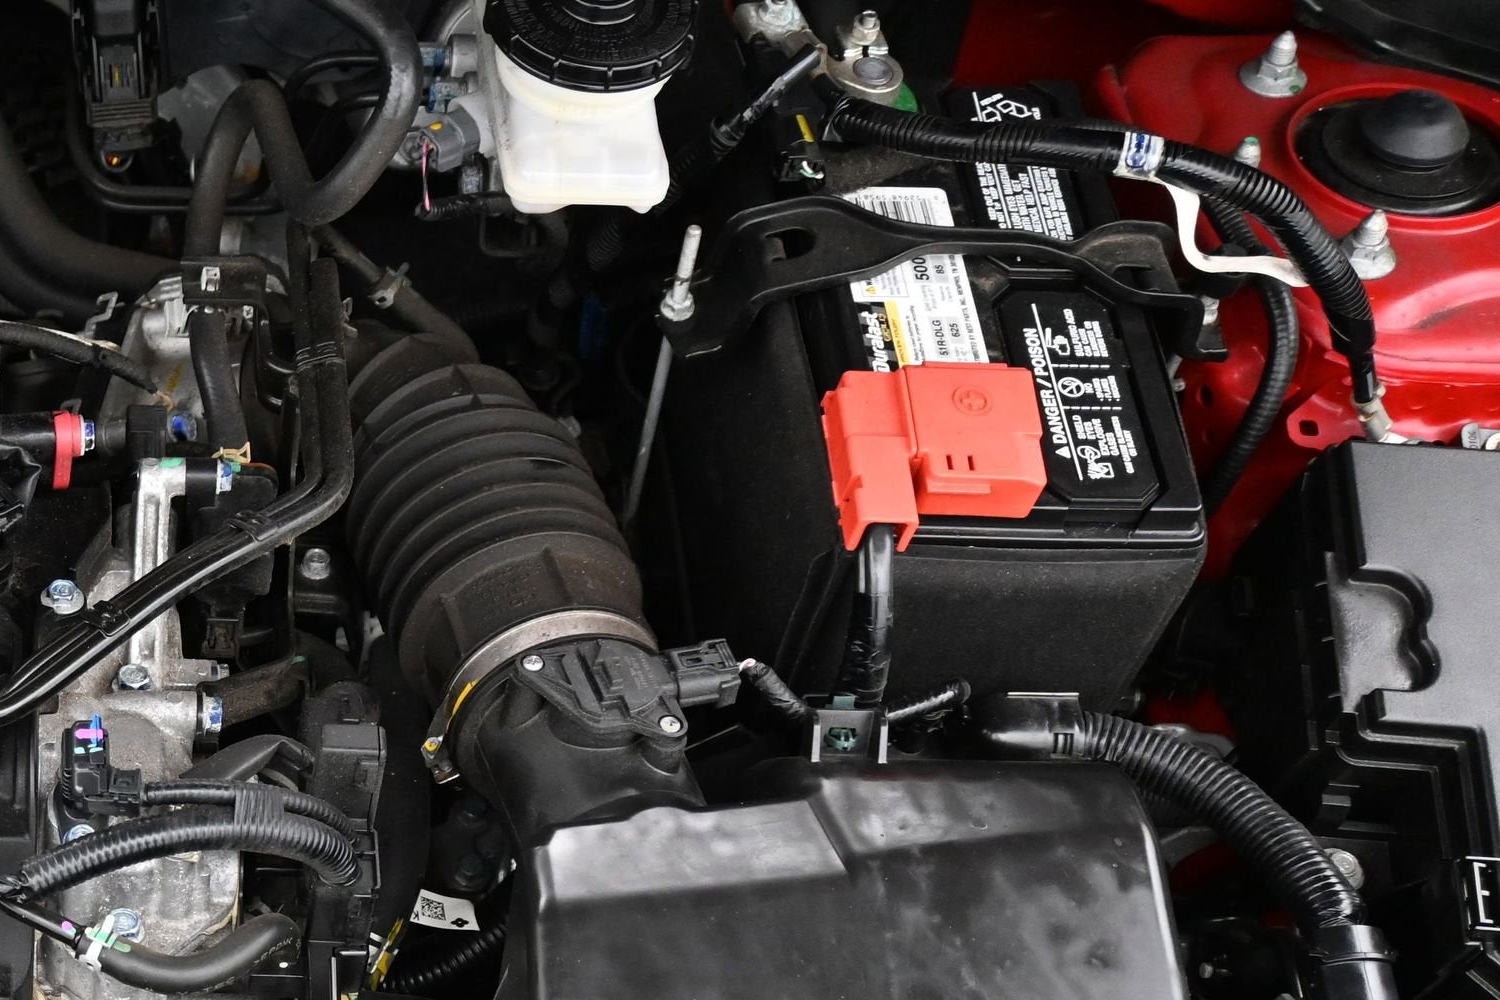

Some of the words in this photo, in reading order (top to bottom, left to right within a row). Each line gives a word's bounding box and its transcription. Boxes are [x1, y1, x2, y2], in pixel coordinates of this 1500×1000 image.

[1010, 179, 1022, 192] GET
[1005, 196, 1019, 212] EYES
[1023, 189, 1035, 205] HELP
[1010, 211, 1024, 229] LUSH
[911, 257, 930, 281] 500
[934, 264, 945, 275] 85
[932, 319, 949, 356] 51R-DLG
[951, 323, 961, 337] 625
[861, 311, 891, 372] Duralast
[1023, 328, 1049, 376] POISON
[1040, 389, 1067, 444] DANGER
[1092, 419, 1112, 456] EXPLOSIVE
